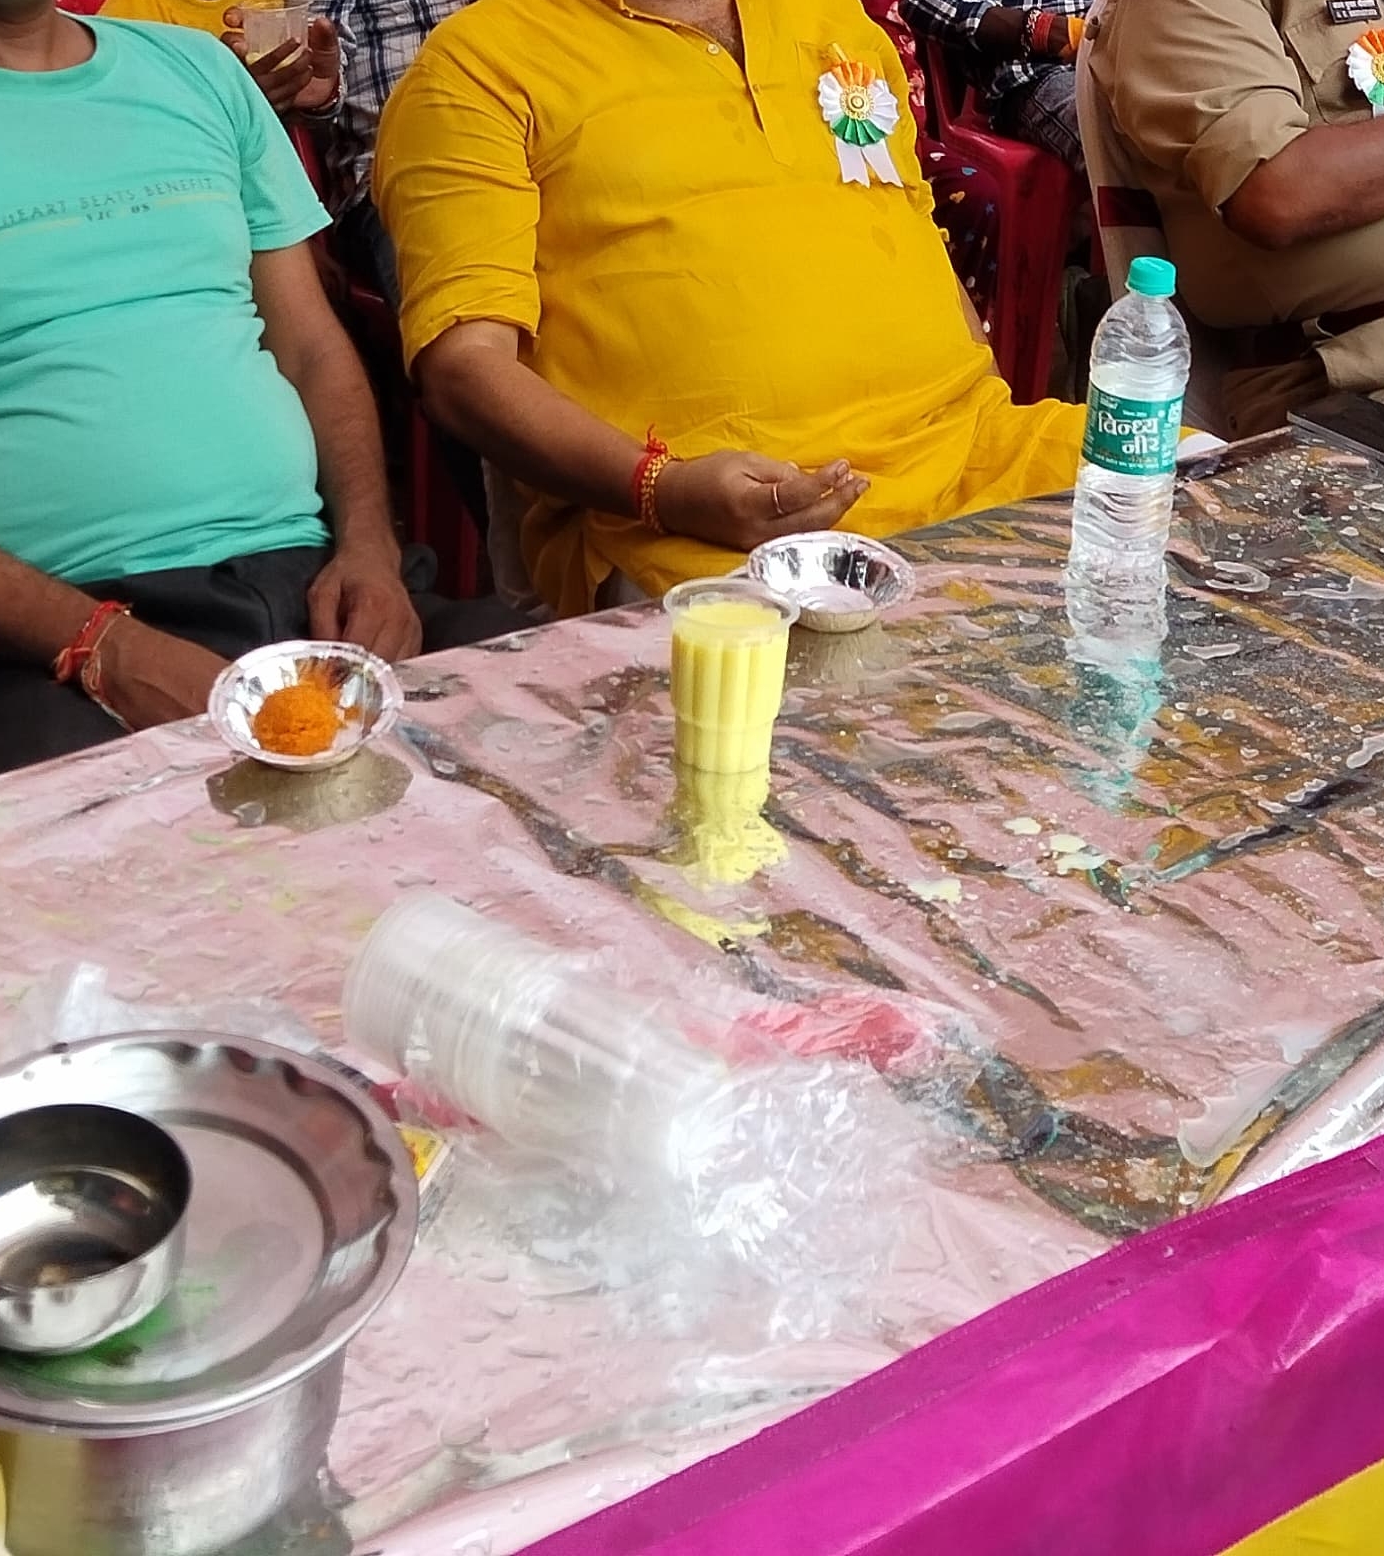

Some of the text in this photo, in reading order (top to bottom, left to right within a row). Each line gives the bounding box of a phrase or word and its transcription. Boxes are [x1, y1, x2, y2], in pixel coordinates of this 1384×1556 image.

[78, 189, 136, 211] BEATS
[143, 176, 214, 198] BENEFIT
[1098, 410, 1158, 436] विन्ध्य
[1121, 434, 1159, 455] नीर
